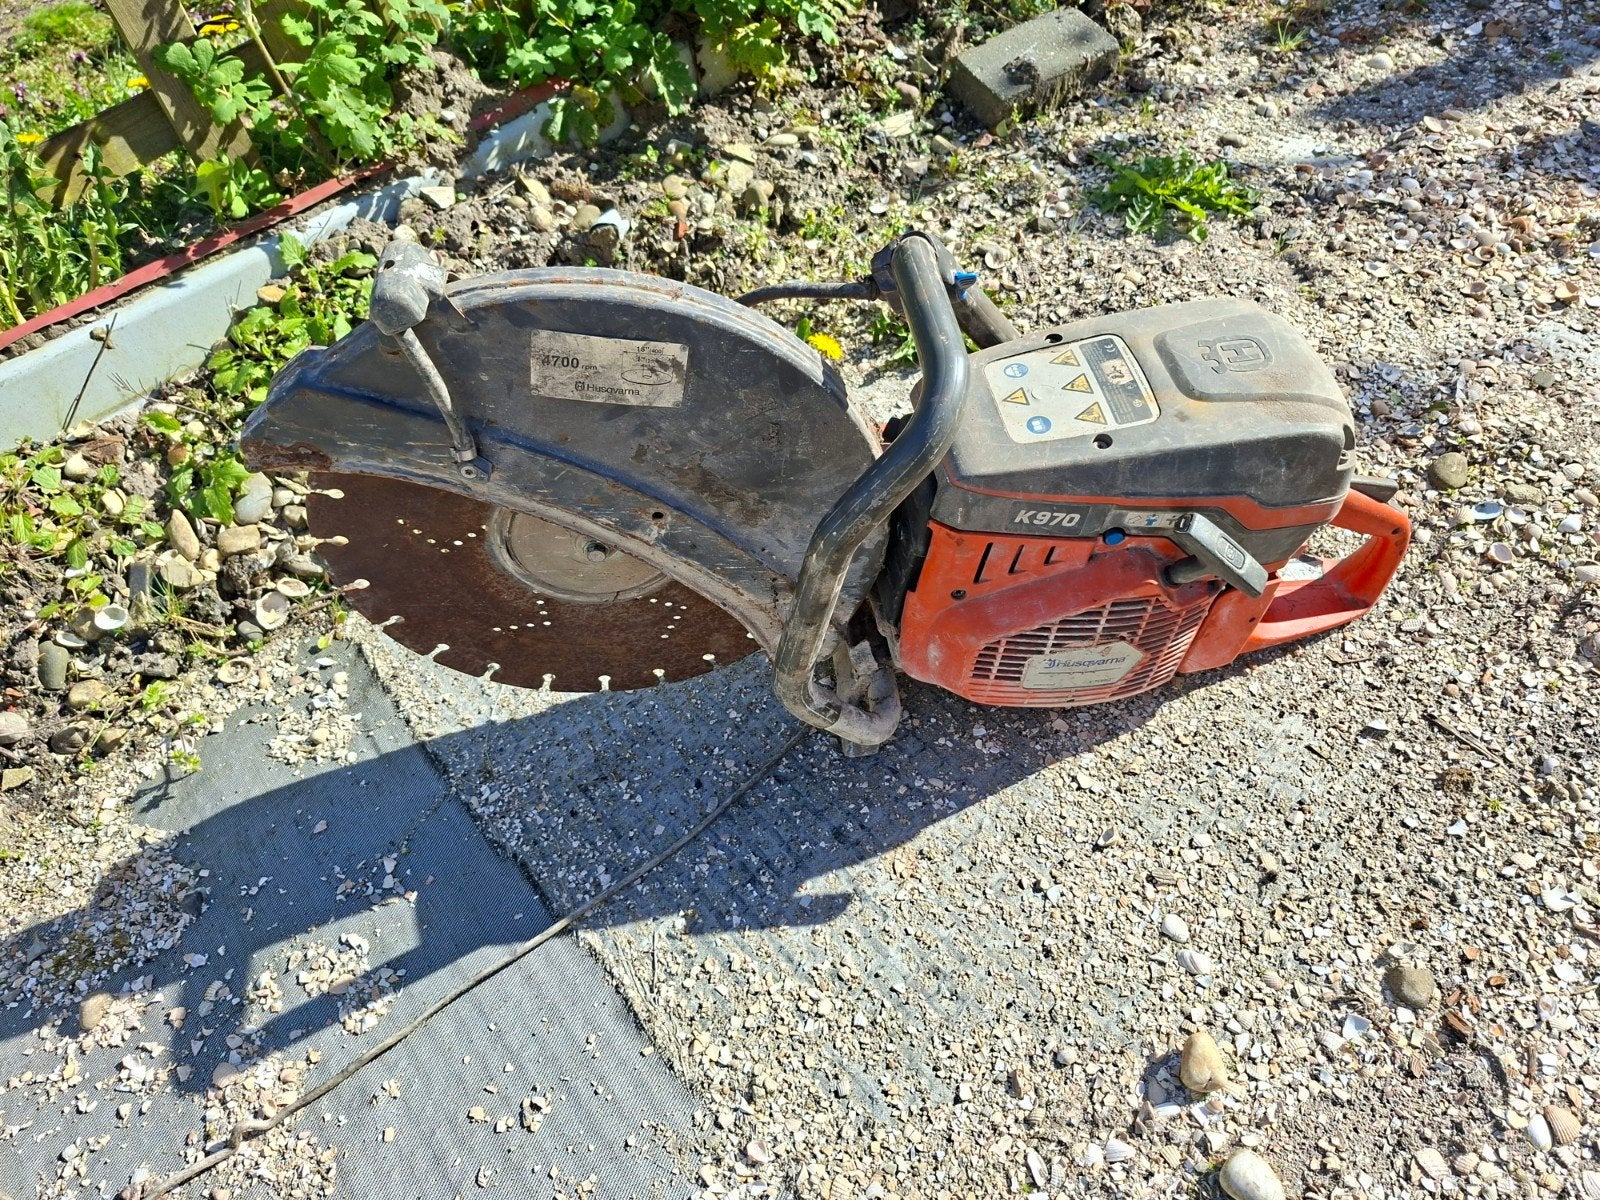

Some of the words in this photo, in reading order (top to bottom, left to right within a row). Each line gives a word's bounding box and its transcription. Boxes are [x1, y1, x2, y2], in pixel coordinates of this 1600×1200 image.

[542, 355, 579, 369] 4700
[586, 383, 640, 396] Husqvarna
[1056, 656, 1126, 668] Husqvarna
